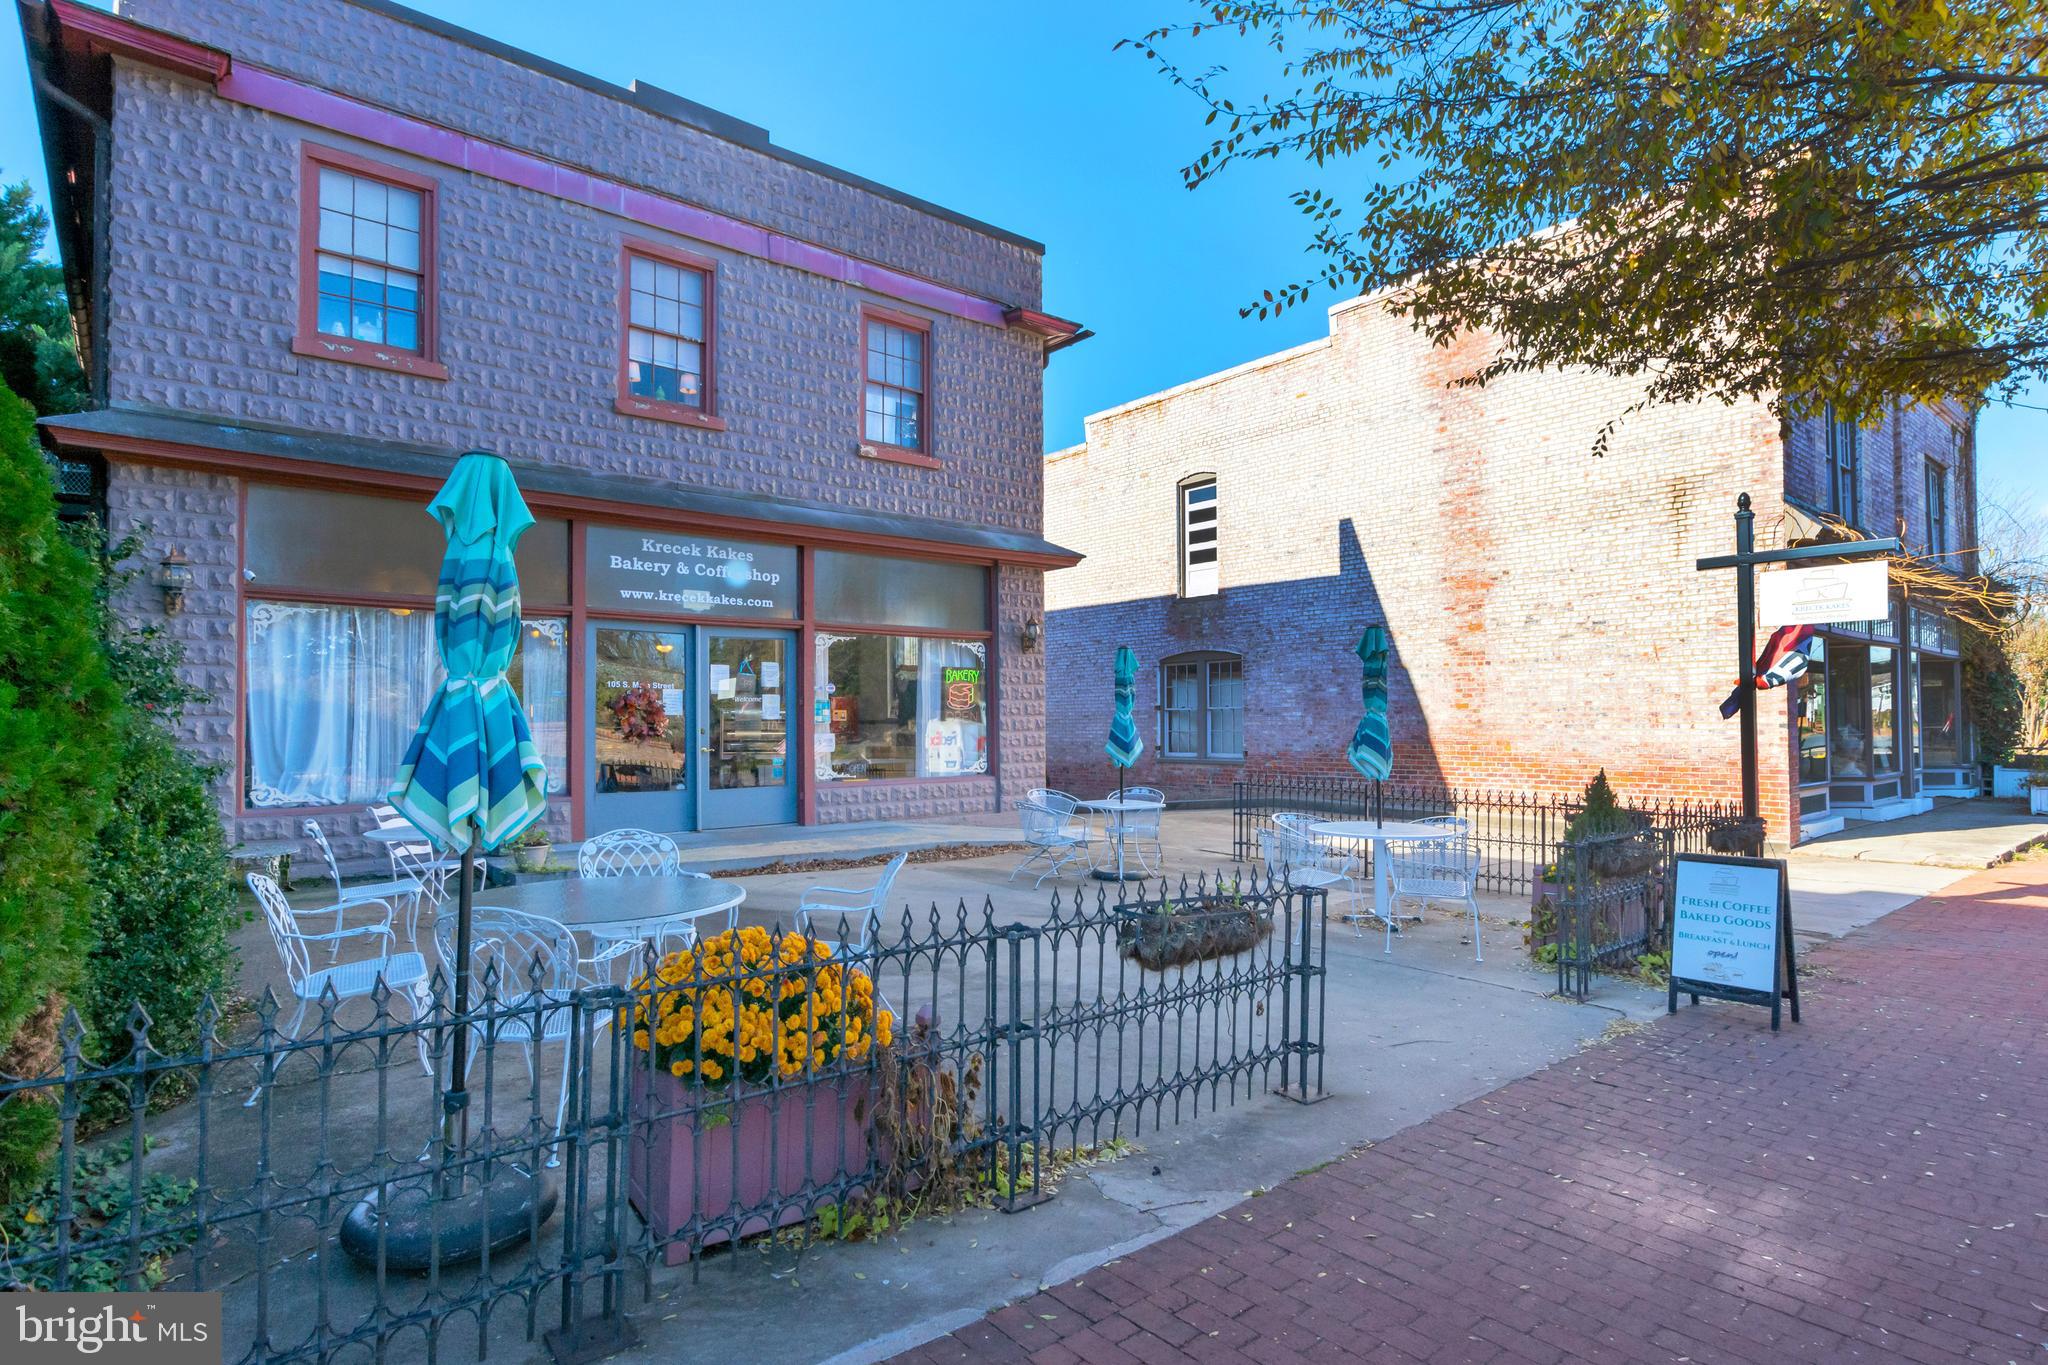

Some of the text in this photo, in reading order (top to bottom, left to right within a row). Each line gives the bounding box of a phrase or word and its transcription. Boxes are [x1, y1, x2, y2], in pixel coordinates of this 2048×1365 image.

[641, 538, 754, 562] Krecek Kakes
[610, 555, 671, 576] Bakery
[676, 562, 689, 575] &
[620, 589, 773, 608] www.krecekkakes.com
[945, 669, 980, 684] BAKERY
[735, 695, 762, 703] Welcome
[945, 711, 977, 721] OPEN
[1681, 896, 1771, 915] FRESH COFFEE
[1680, 910, 1771, 929] BAKED GOODS
[1678, 931, 1726, 945] BREAKFAST
[1736, 939, 1770, 951] LUNCH
